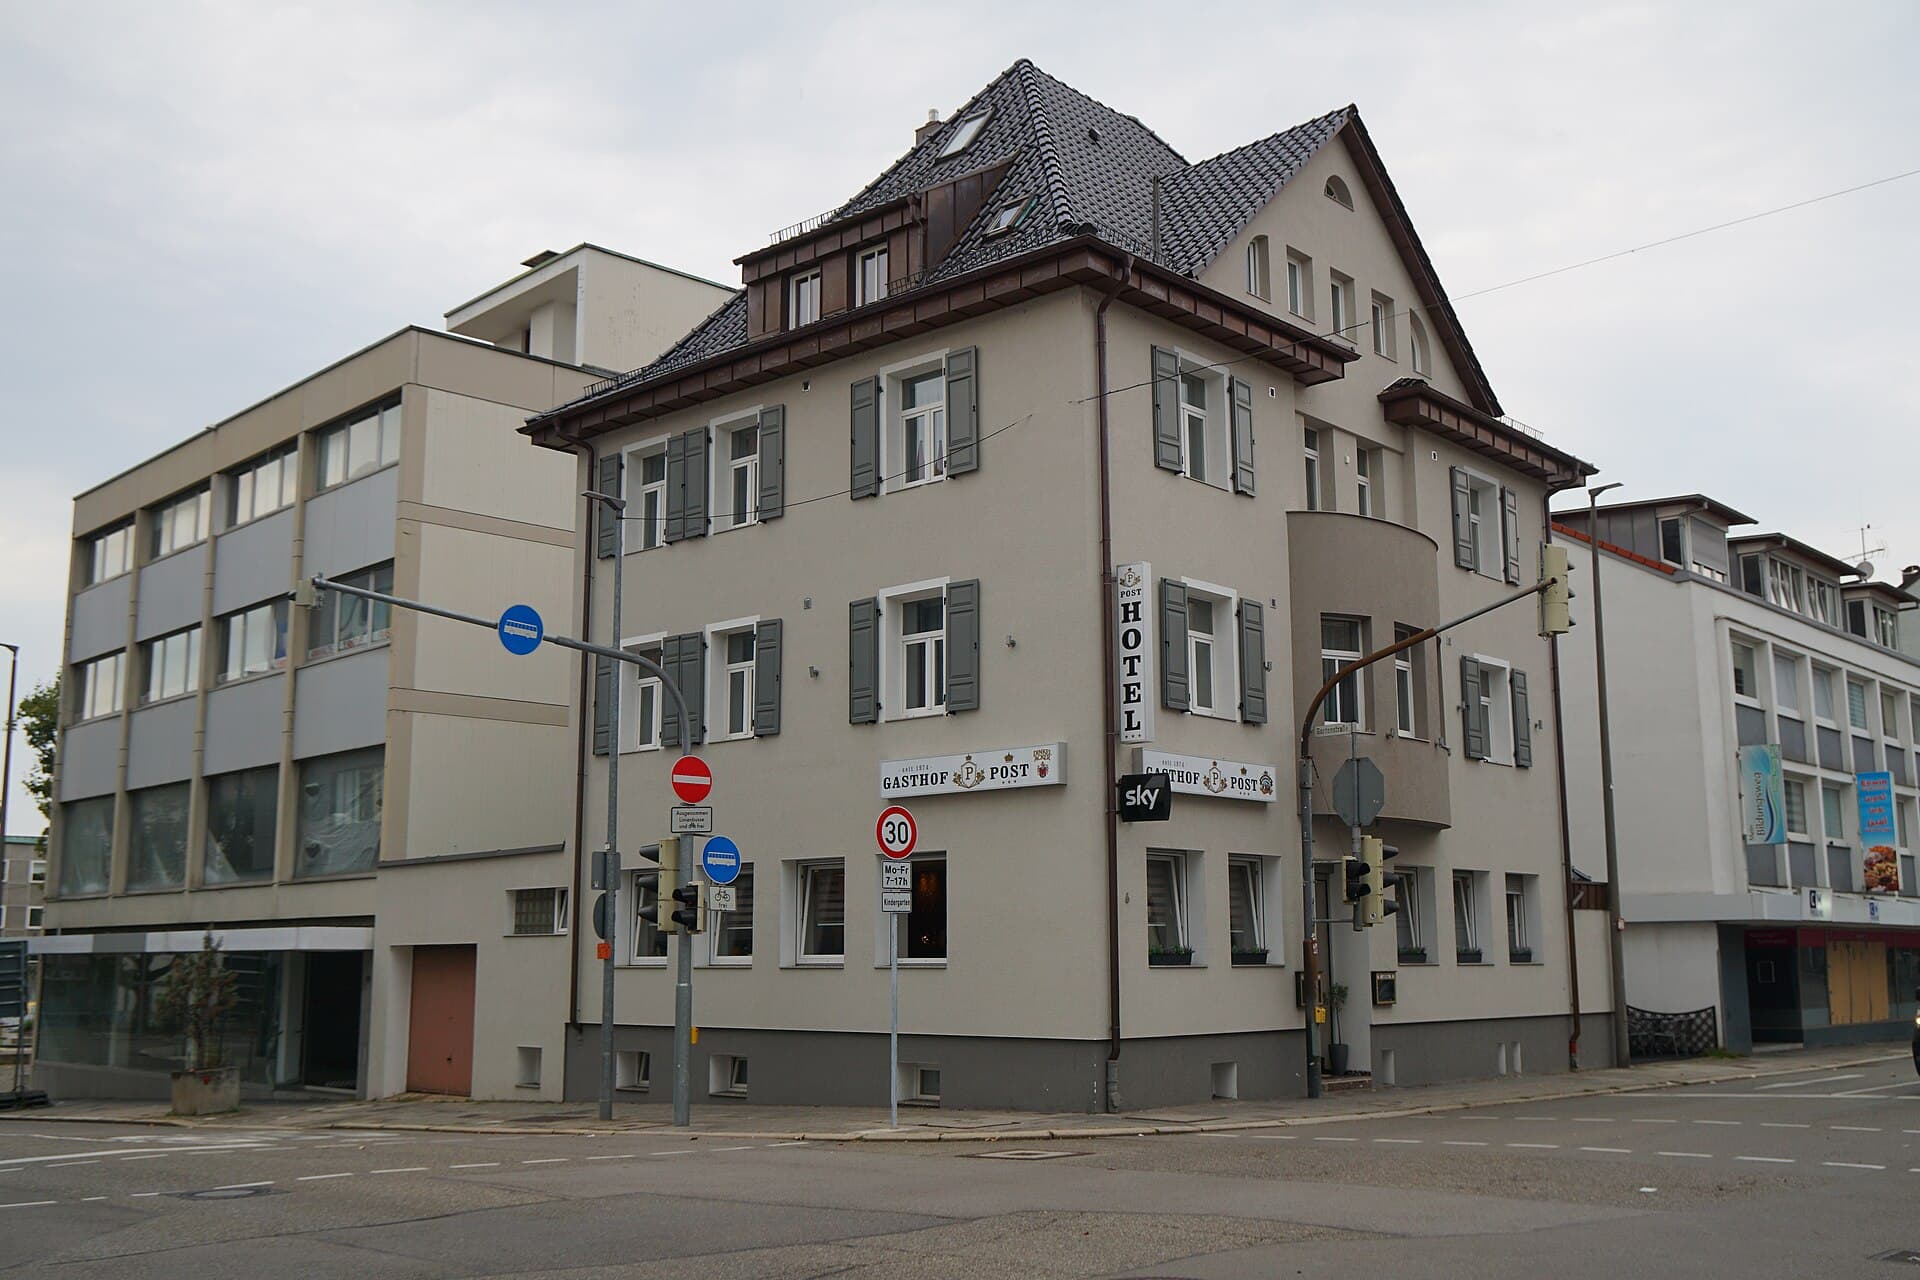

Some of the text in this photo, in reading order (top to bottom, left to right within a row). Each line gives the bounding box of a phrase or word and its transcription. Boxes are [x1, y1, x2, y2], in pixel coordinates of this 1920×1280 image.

[1120, 588, 1142, 598] POST
[1120, 601, 1142, 732] HOTEL
[883, 763, 1030, 790] GASTHOF P POST
[1212, 772, 1219, 785] P
[1231, 776, 1258, 792] POST
[1125, 784, 1160, 810] sky
[1753, 772, 1766, 836] Bildungsweg
[885, 821, 909, 844] 30
[884, 865, 909, 875] Mo-Fr
[885, 876, 908, 886] 7-17h
[883, 898, 910, 908] Kindergarten
